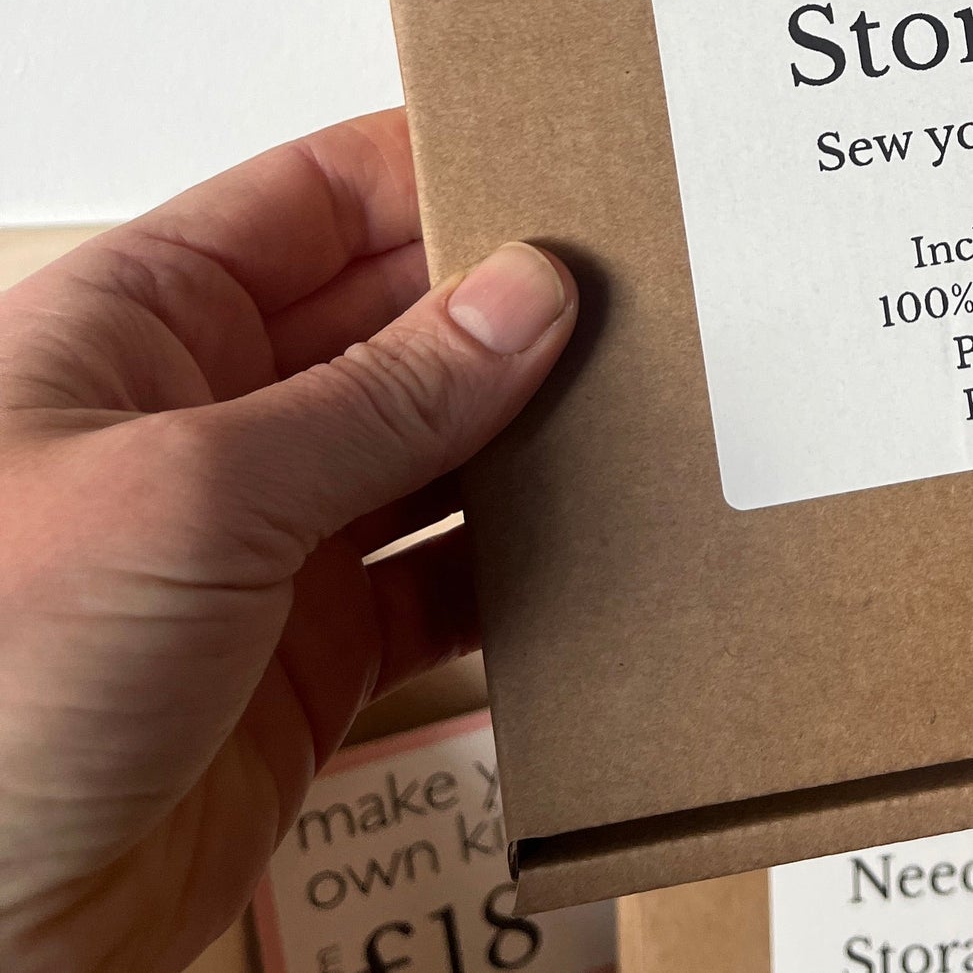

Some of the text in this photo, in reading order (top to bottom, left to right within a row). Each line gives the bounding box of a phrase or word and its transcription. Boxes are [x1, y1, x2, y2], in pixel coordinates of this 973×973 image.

[816, 130, 914, 172] Sew
[297, 770, 458, 851] make
[305, 810, 506, 911] own ki
